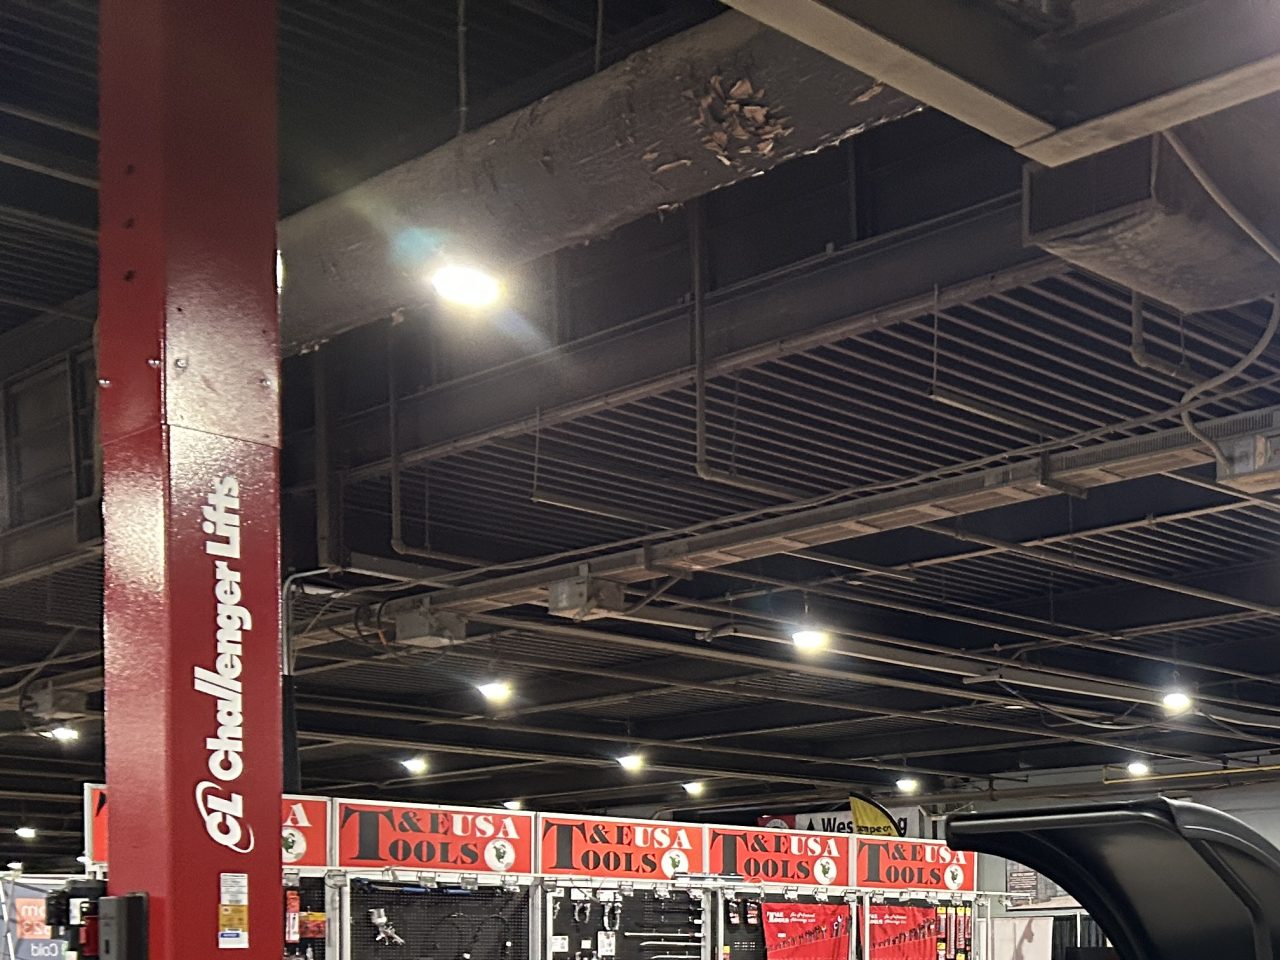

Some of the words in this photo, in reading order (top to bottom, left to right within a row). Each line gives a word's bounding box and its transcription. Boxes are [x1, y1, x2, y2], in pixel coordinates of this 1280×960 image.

[201, 475, 240, 559] Lifts
[194, 560, 252, 782] Challenger
[341, 819, 479, 864] TOOLS
[542, 831, 657, 873] TOOLS
[710, 842, 810, 879] TOOLS
[858, 852, 941, 884] TOOLS
